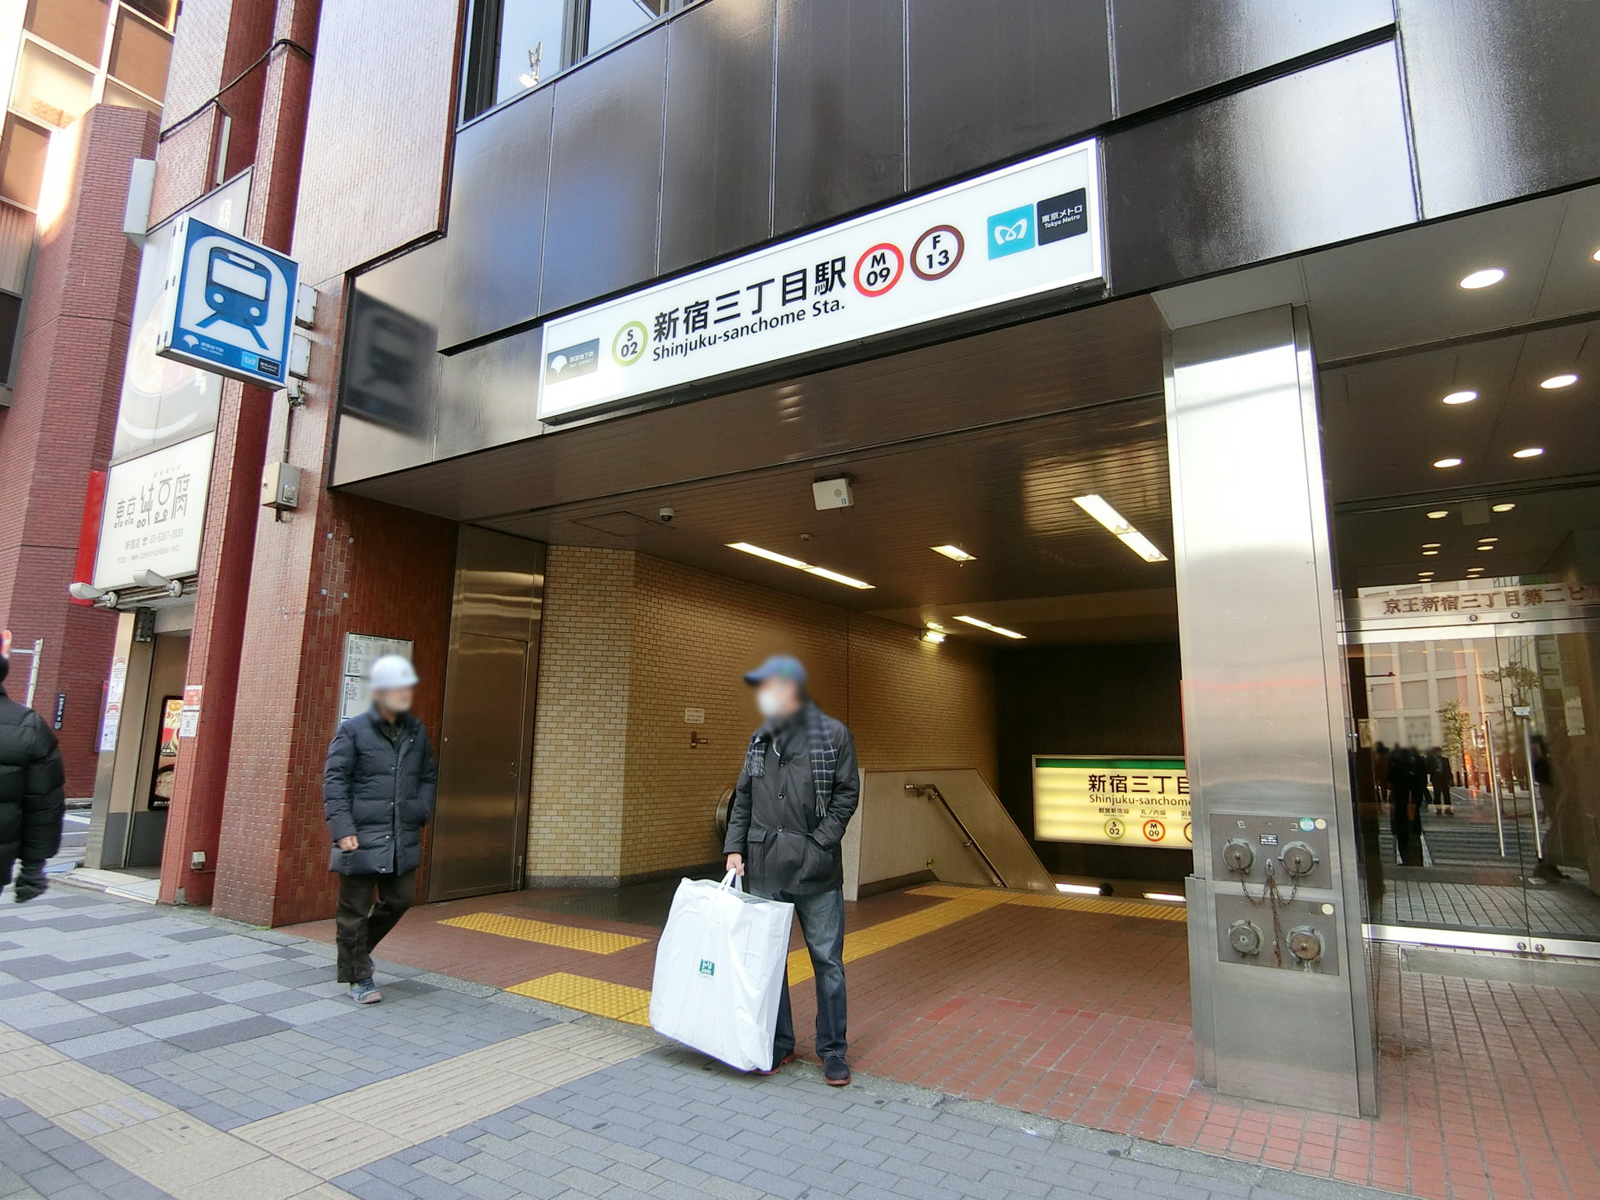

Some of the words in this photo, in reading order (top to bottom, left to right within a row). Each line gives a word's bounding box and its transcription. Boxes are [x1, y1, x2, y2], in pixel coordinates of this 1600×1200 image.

[1041, 204, 1084, 223] 東京メトロ
[1043, 218, 1062, 229] Tokyo
[1062, 213, 1081, 225] Metro
[932, 234, 941, 250] F
[870, 252, 887, 269] M
[926, 249, 950, 269] 13
[866, 267, 891, 287] 09
[653, 256, 847, 343] 新宿三丁目駅
[626, 329, 634, 342] S
[653, 308, 806, 362] Shinjuku-sanchome
[812, 299, 846, 318] Sta.
[620, 341, 639, 358] 02
[1088, 774, 1190, 794] 新宿三丁目
[1109, 827, 1120, 835] 02
